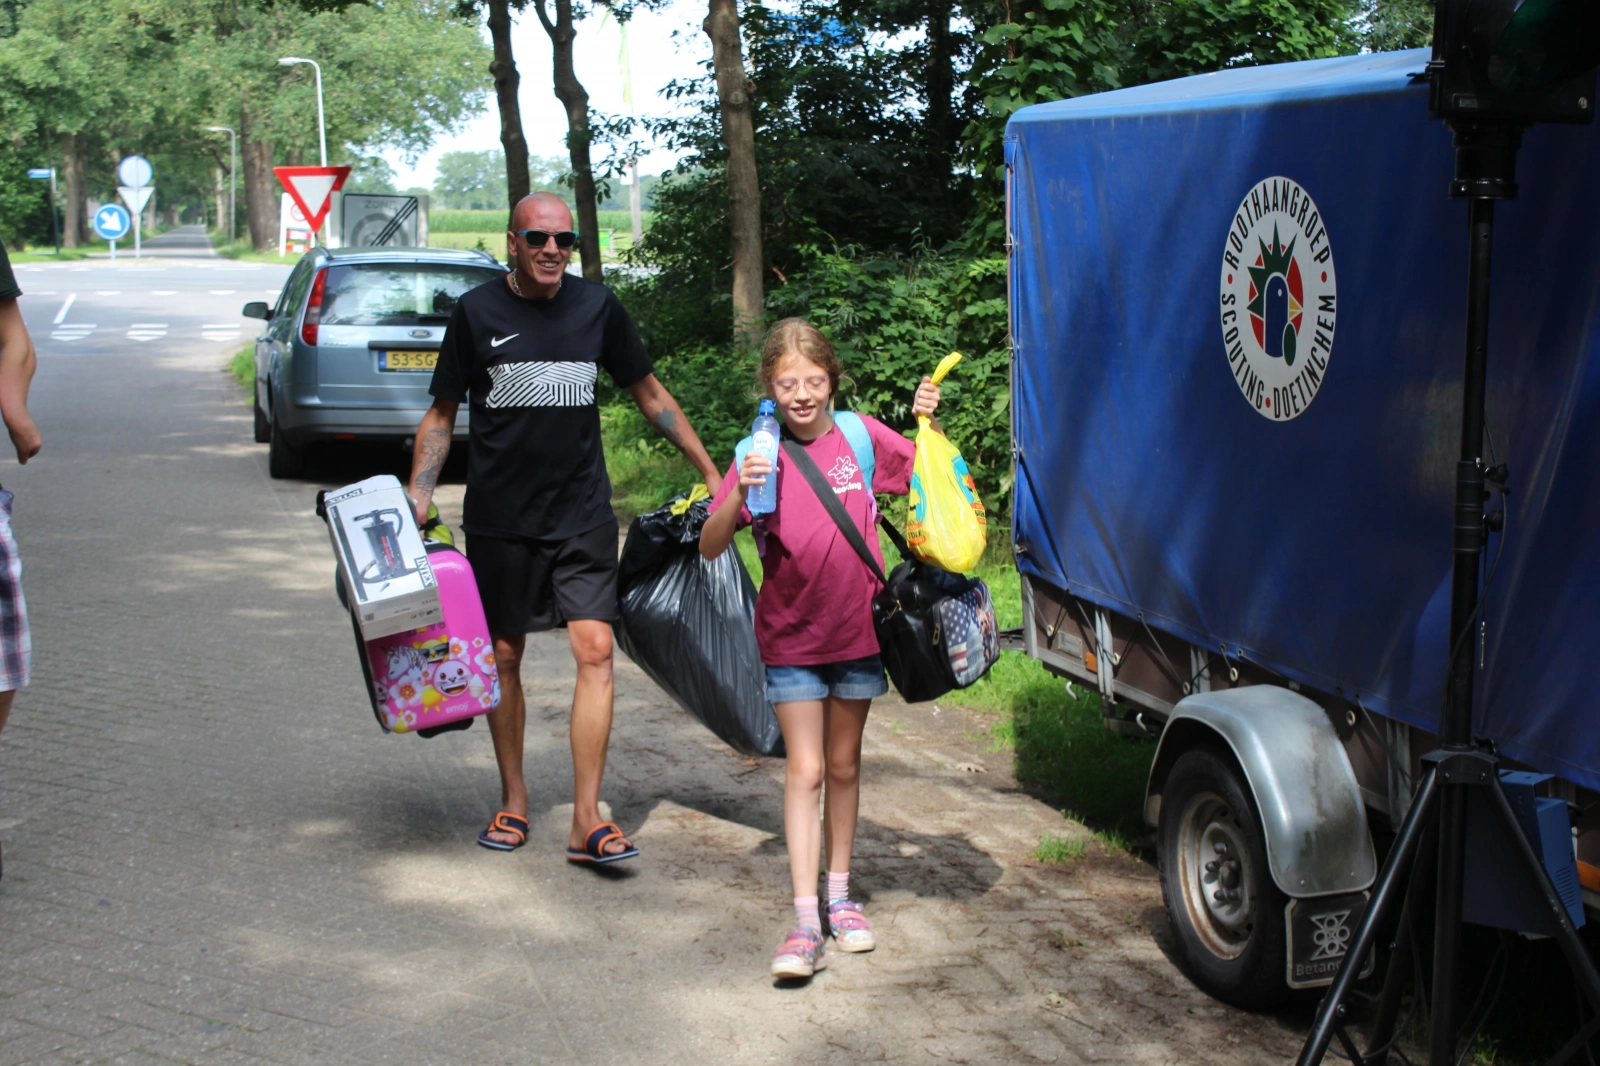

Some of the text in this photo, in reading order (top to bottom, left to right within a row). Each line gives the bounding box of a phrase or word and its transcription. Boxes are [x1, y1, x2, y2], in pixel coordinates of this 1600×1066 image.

[1224, 179, 1331, 270] ROOTHAANGROEP
[392, 353, 438, 367] 53-SG-
[1221, 293, 1264, 410] SCOUTING
[1273, 295, 1336, 419] DOETINCHEM
[832, 482, 862, 495] Scoing
[416, 556, 435, 587] INTEX
